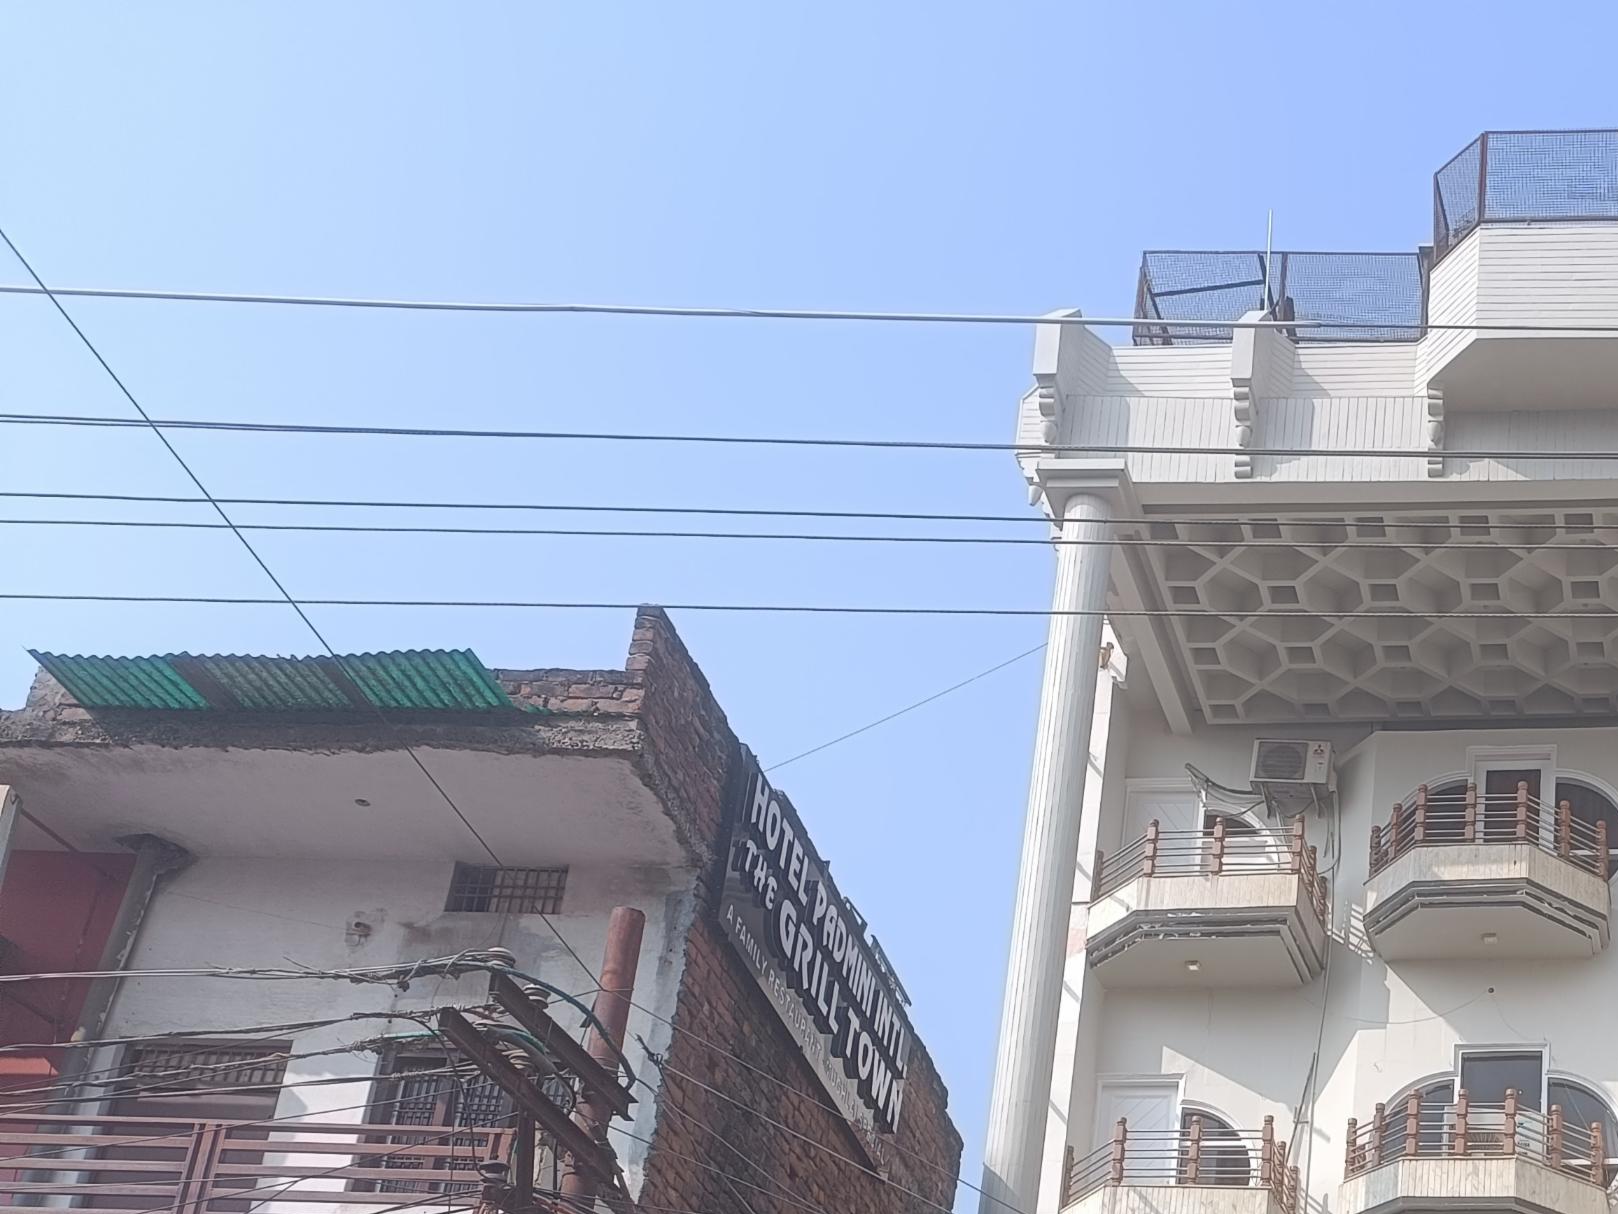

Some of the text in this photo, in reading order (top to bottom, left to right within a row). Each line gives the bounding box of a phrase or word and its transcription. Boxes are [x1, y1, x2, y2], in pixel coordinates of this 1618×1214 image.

[727, 904, 734, 925] A
[735, 916, 768, 975] FAMILY
[745, 840, 904, 1134] THE GRILL TOWN
[751, 773, 809, 906] HOTEL
[813, 880, 876, 1019] PADMINI
